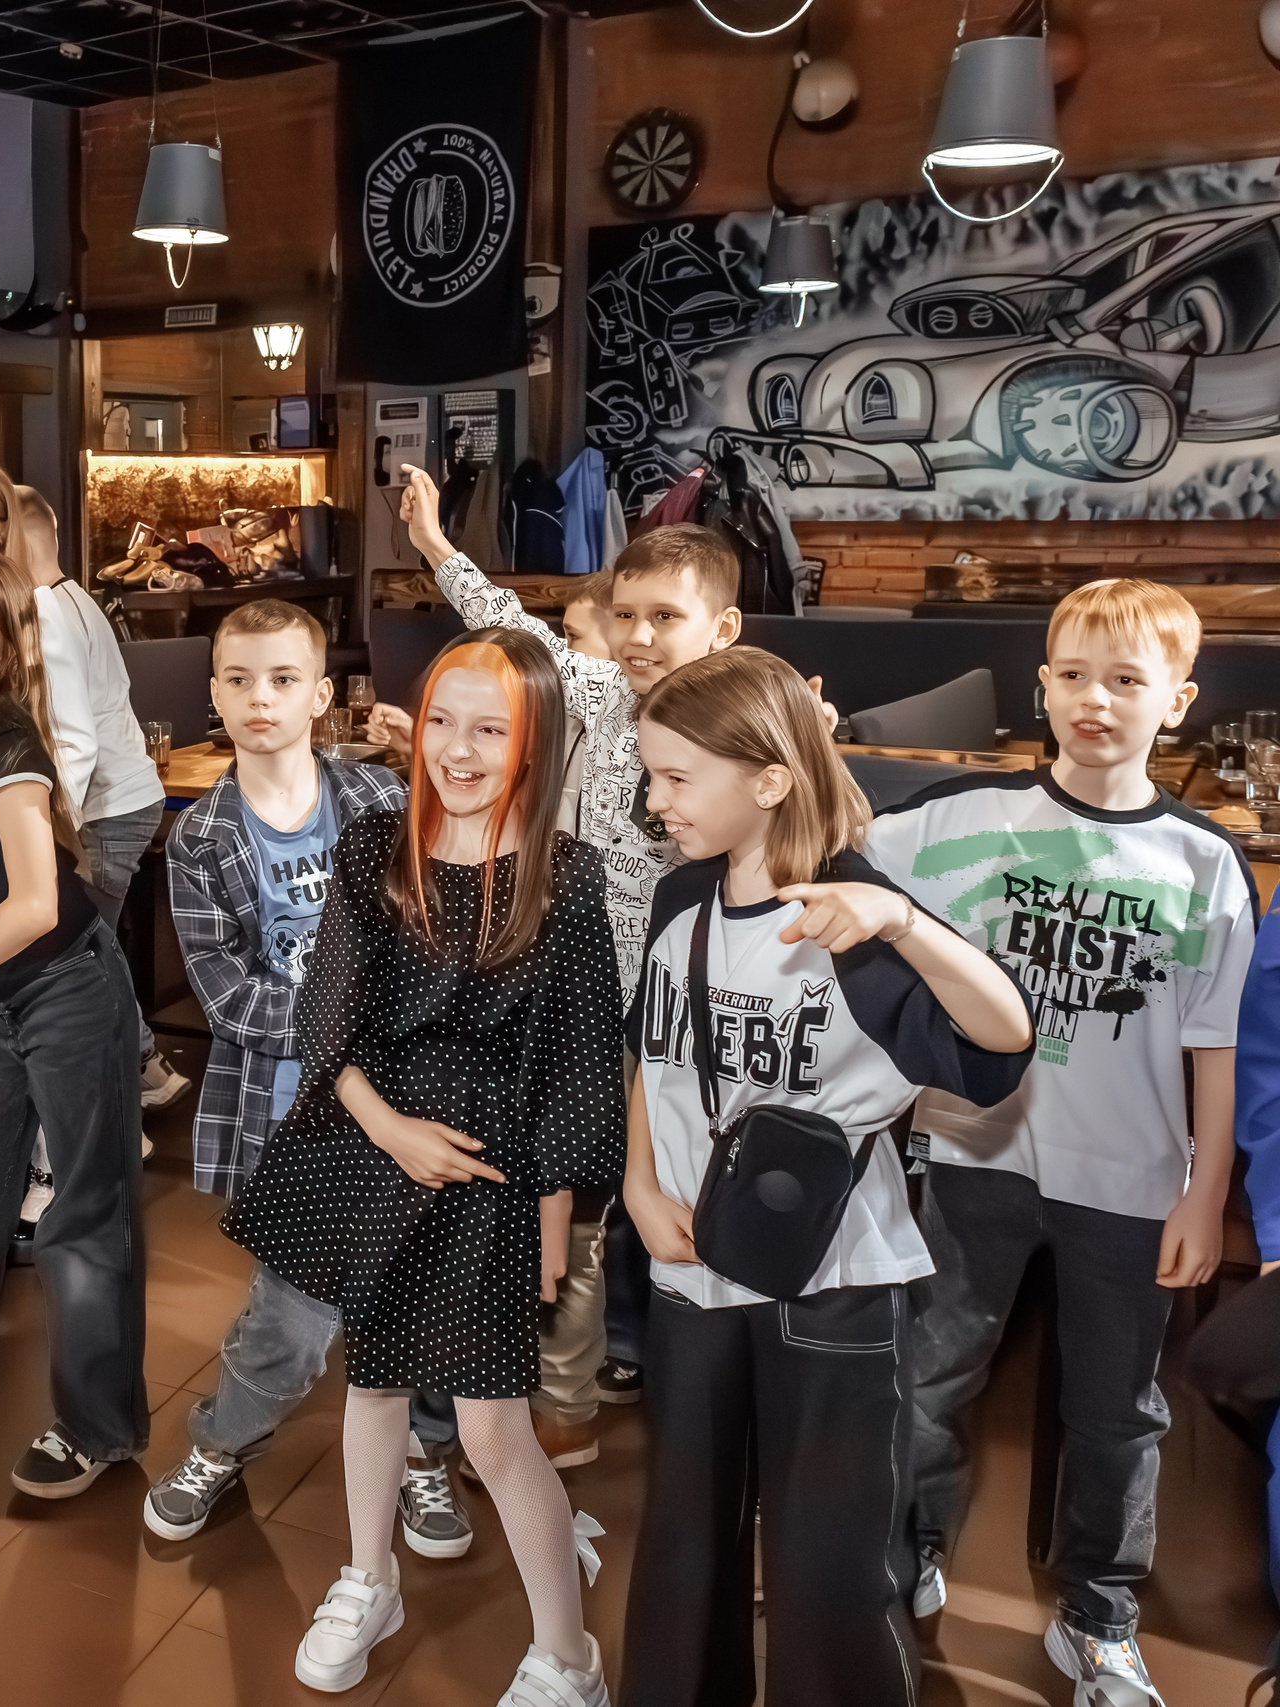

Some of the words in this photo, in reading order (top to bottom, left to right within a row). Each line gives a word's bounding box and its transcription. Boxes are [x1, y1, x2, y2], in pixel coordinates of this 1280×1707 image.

[442, 133, 475, 154] 100%
[369, 146, 418, 290] DRANDULET
[478, 148, 505, 224] NATURAL
[443, 232, 500, 295] PRODUCT
[1003, 872, 1162, 937] REALITY
[1006, 910, 1137, 976] EXIST
[1023, 963, 1105, 1009] ONLY
[1038, 1005, 1079, 1043] IN
